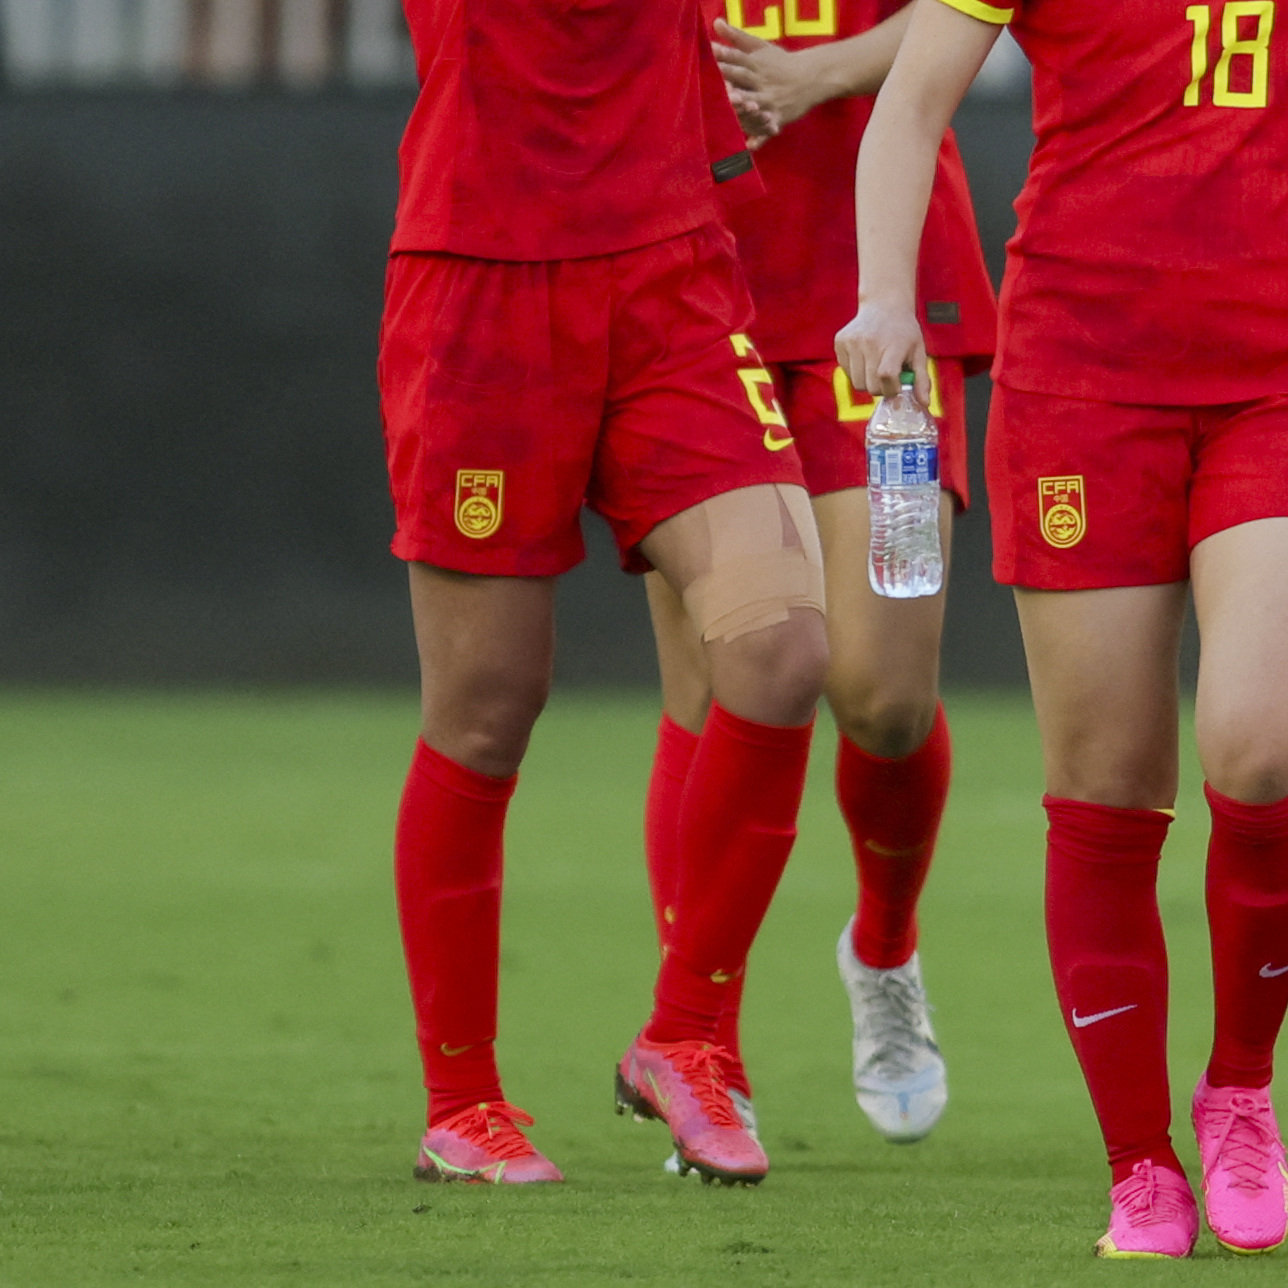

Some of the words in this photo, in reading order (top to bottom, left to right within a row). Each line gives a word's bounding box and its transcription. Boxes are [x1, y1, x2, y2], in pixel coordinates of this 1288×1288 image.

[1183, 0, 1275, 109] 18
[461, 474, 499, 488] CFA
[1042, 481, 1080, 495] CFA
